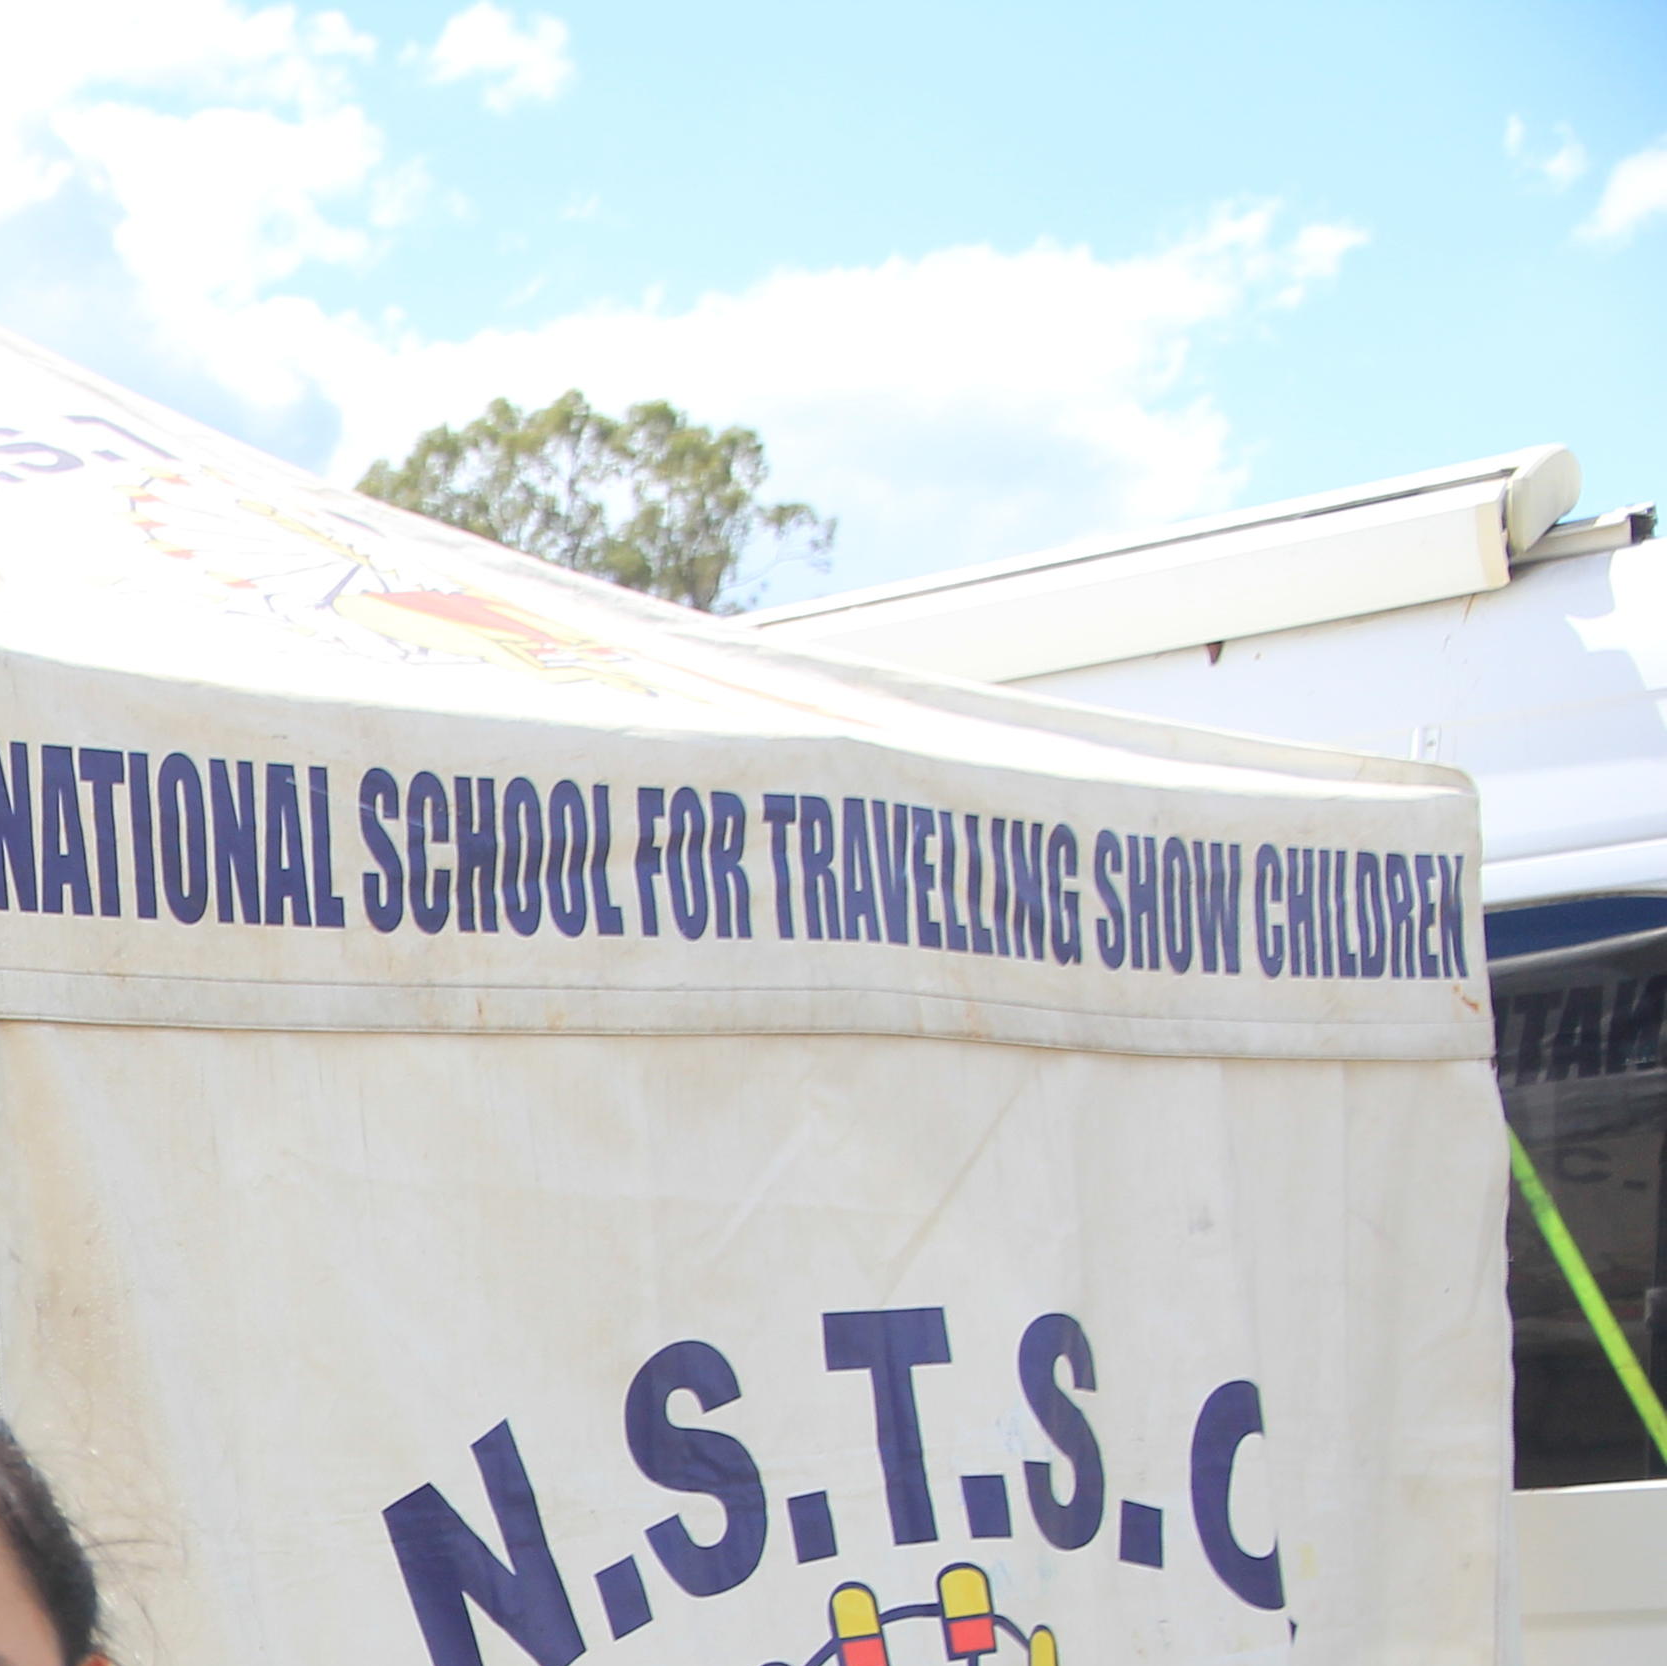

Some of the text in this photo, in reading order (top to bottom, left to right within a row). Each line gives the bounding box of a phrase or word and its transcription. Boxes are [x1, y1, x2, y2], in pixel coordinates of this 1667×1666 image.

[358, 766, 625, 938] SCHOOL
[634, 785, 754, 941] FOR
[762, 793, 1082, 965] TRAVELLING
[1094, 829, 1242, 976] SHOW
[1254, 843, 1469, 979] CHILDREN
